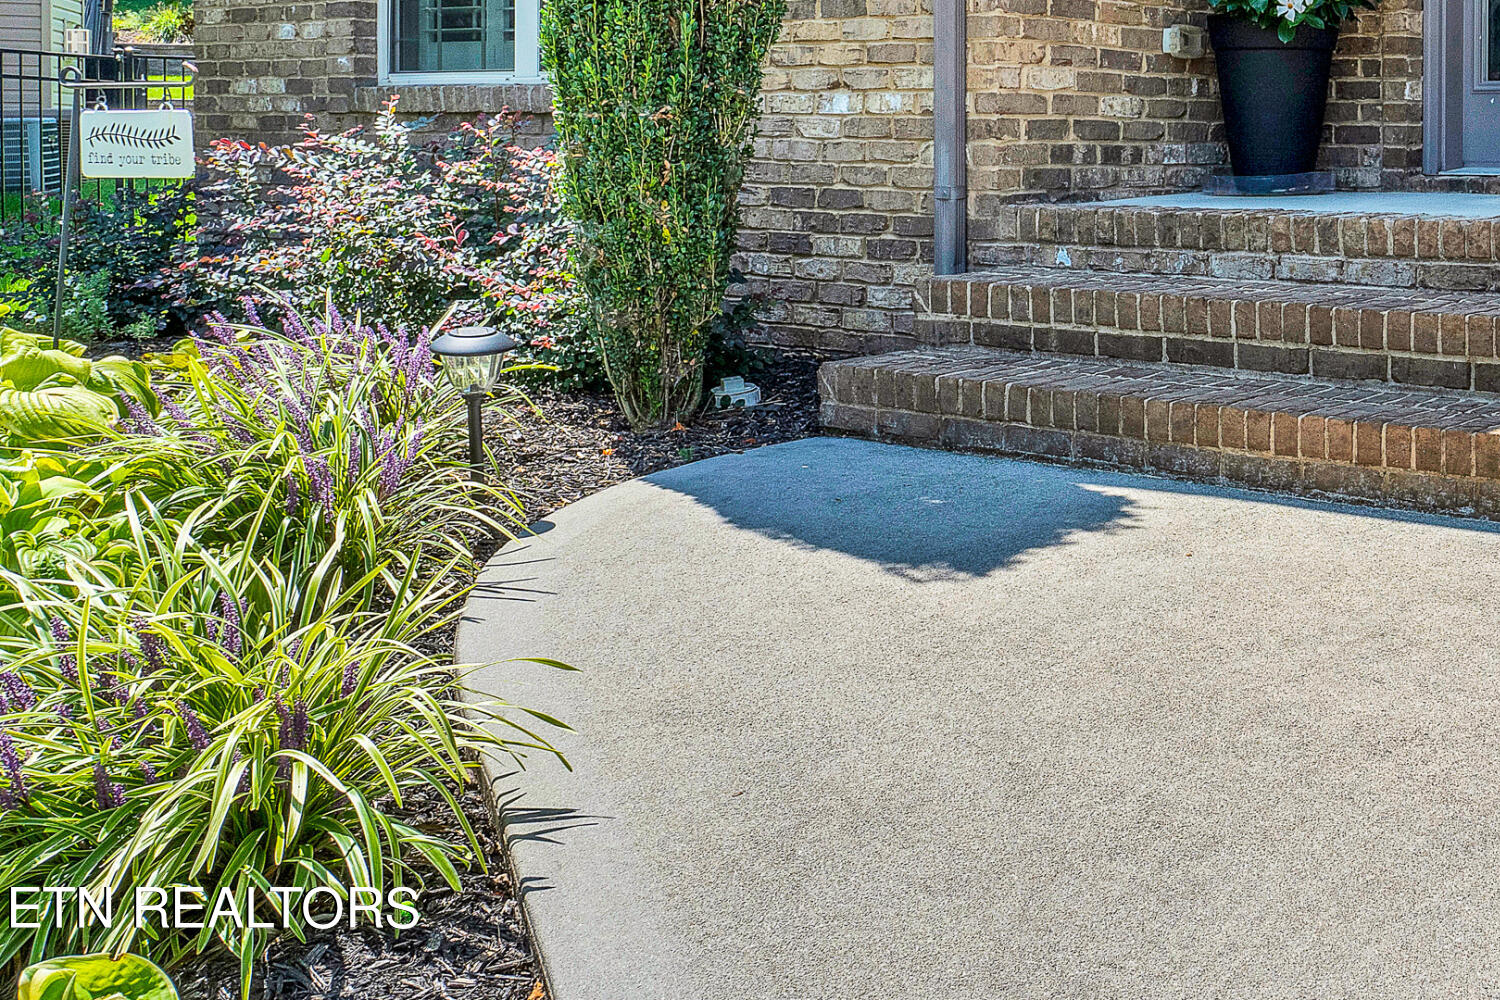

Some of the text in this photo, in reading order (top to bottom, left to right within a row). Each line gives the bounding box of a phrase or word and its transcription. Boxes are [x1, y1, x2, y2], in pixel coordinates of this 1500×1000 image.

[87, 151, 182, 167] find your tribe
